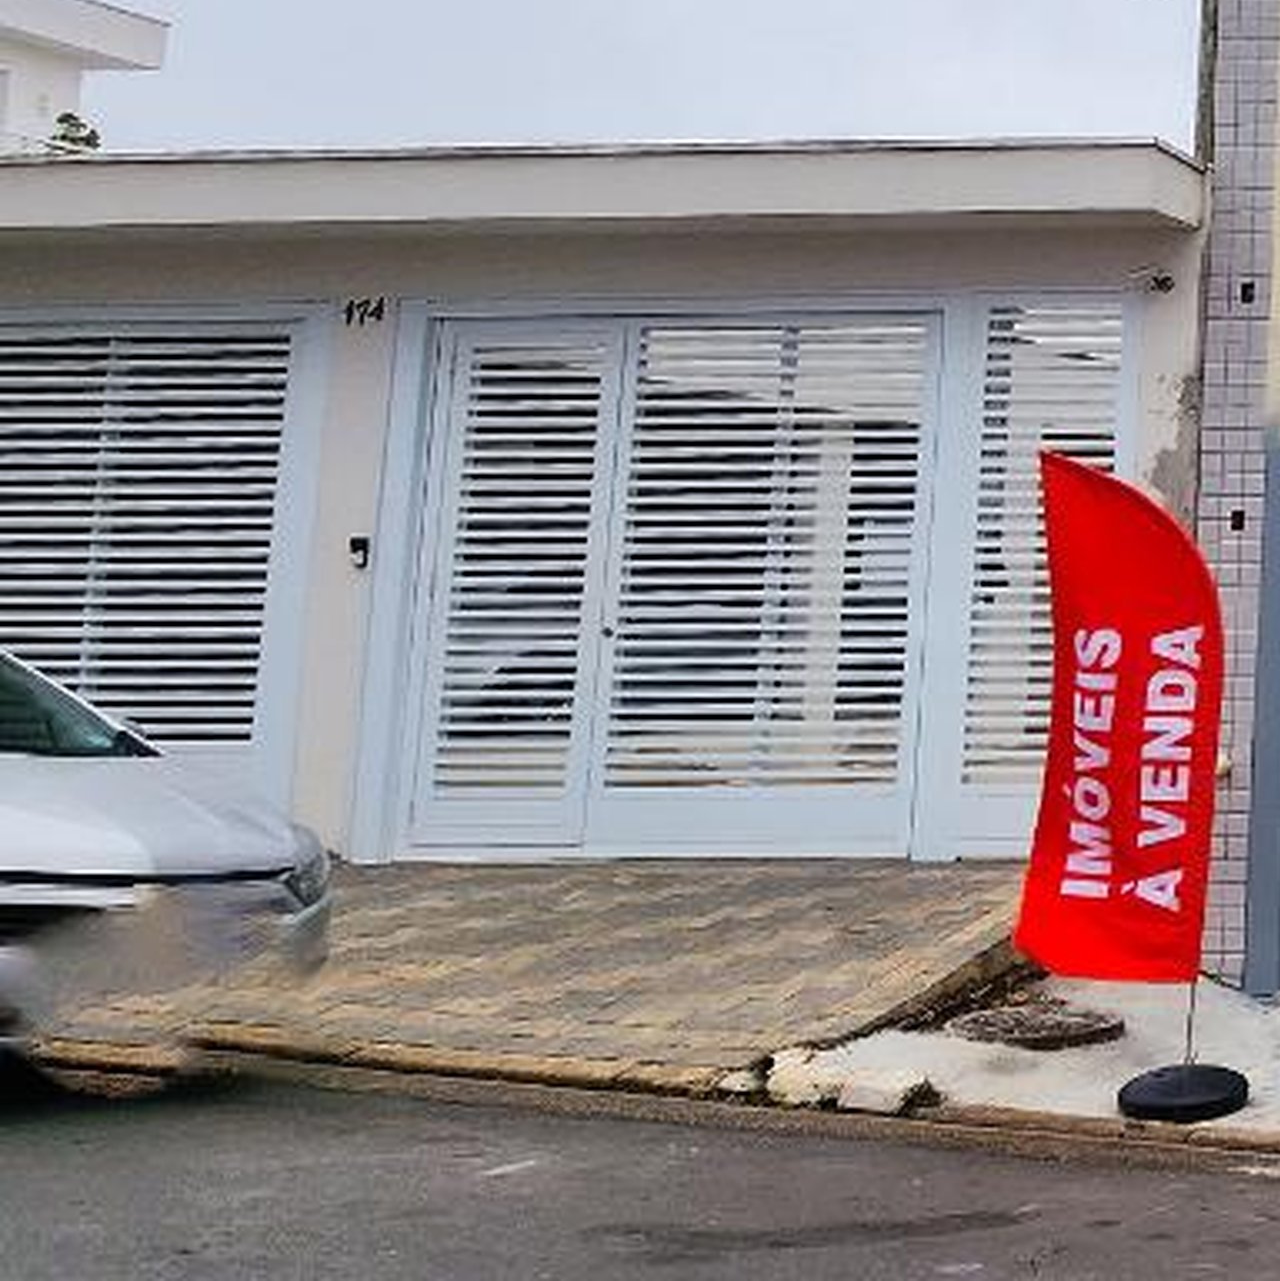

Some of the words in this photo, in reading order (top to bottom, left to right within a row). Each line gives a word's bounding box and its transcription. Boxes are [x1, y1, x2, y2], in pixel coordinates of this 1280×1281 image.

[1061, 627, 1123, 898] IMÓVEIS
[1137, 624, 1205, 849] VENDA
[1122, 869, 1183, 912] À
